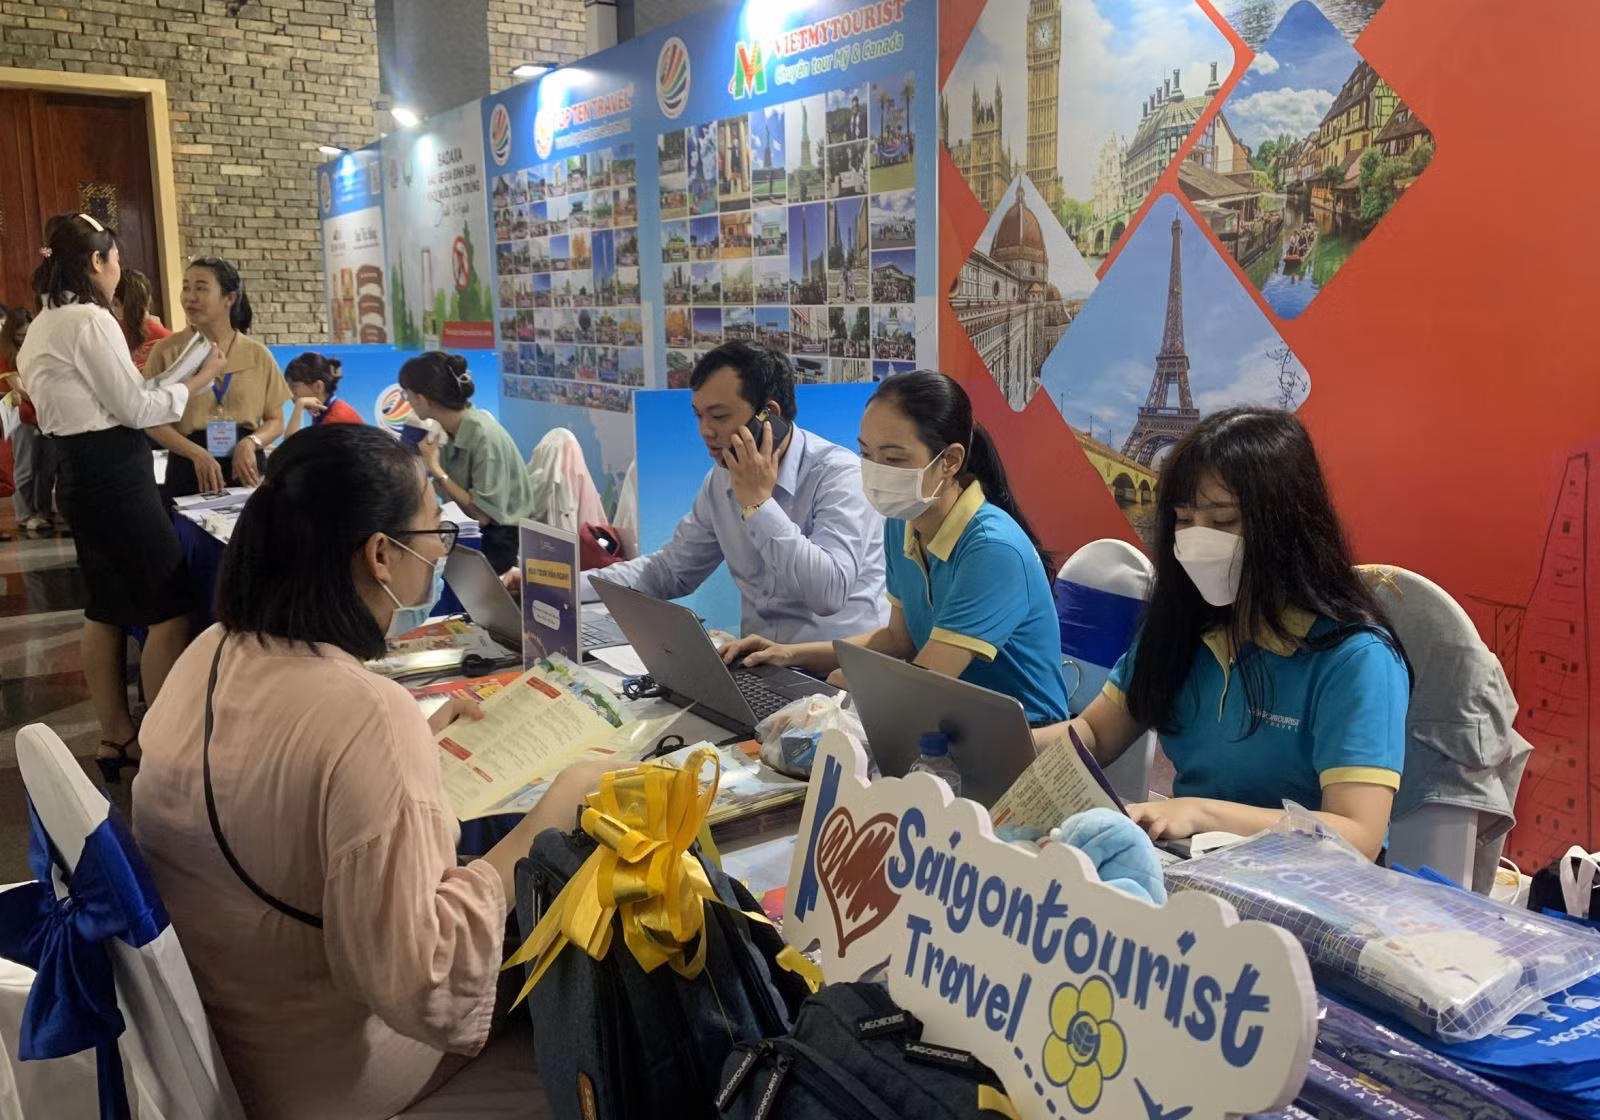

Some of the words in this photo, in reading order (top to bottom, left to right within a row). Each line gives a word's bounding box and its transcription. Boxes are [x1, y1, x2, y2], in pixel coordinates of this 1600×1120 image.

[774, 0, 906, 56] VIETMYTOURIST
[811, 54, 833, 75] tour
[852, 43, 861, 64] &
[862, 32, 904, 61] Canada
[888, 807, 1270, 1067] Saigontourist
[905, 914, 1033, 1042] Travel
